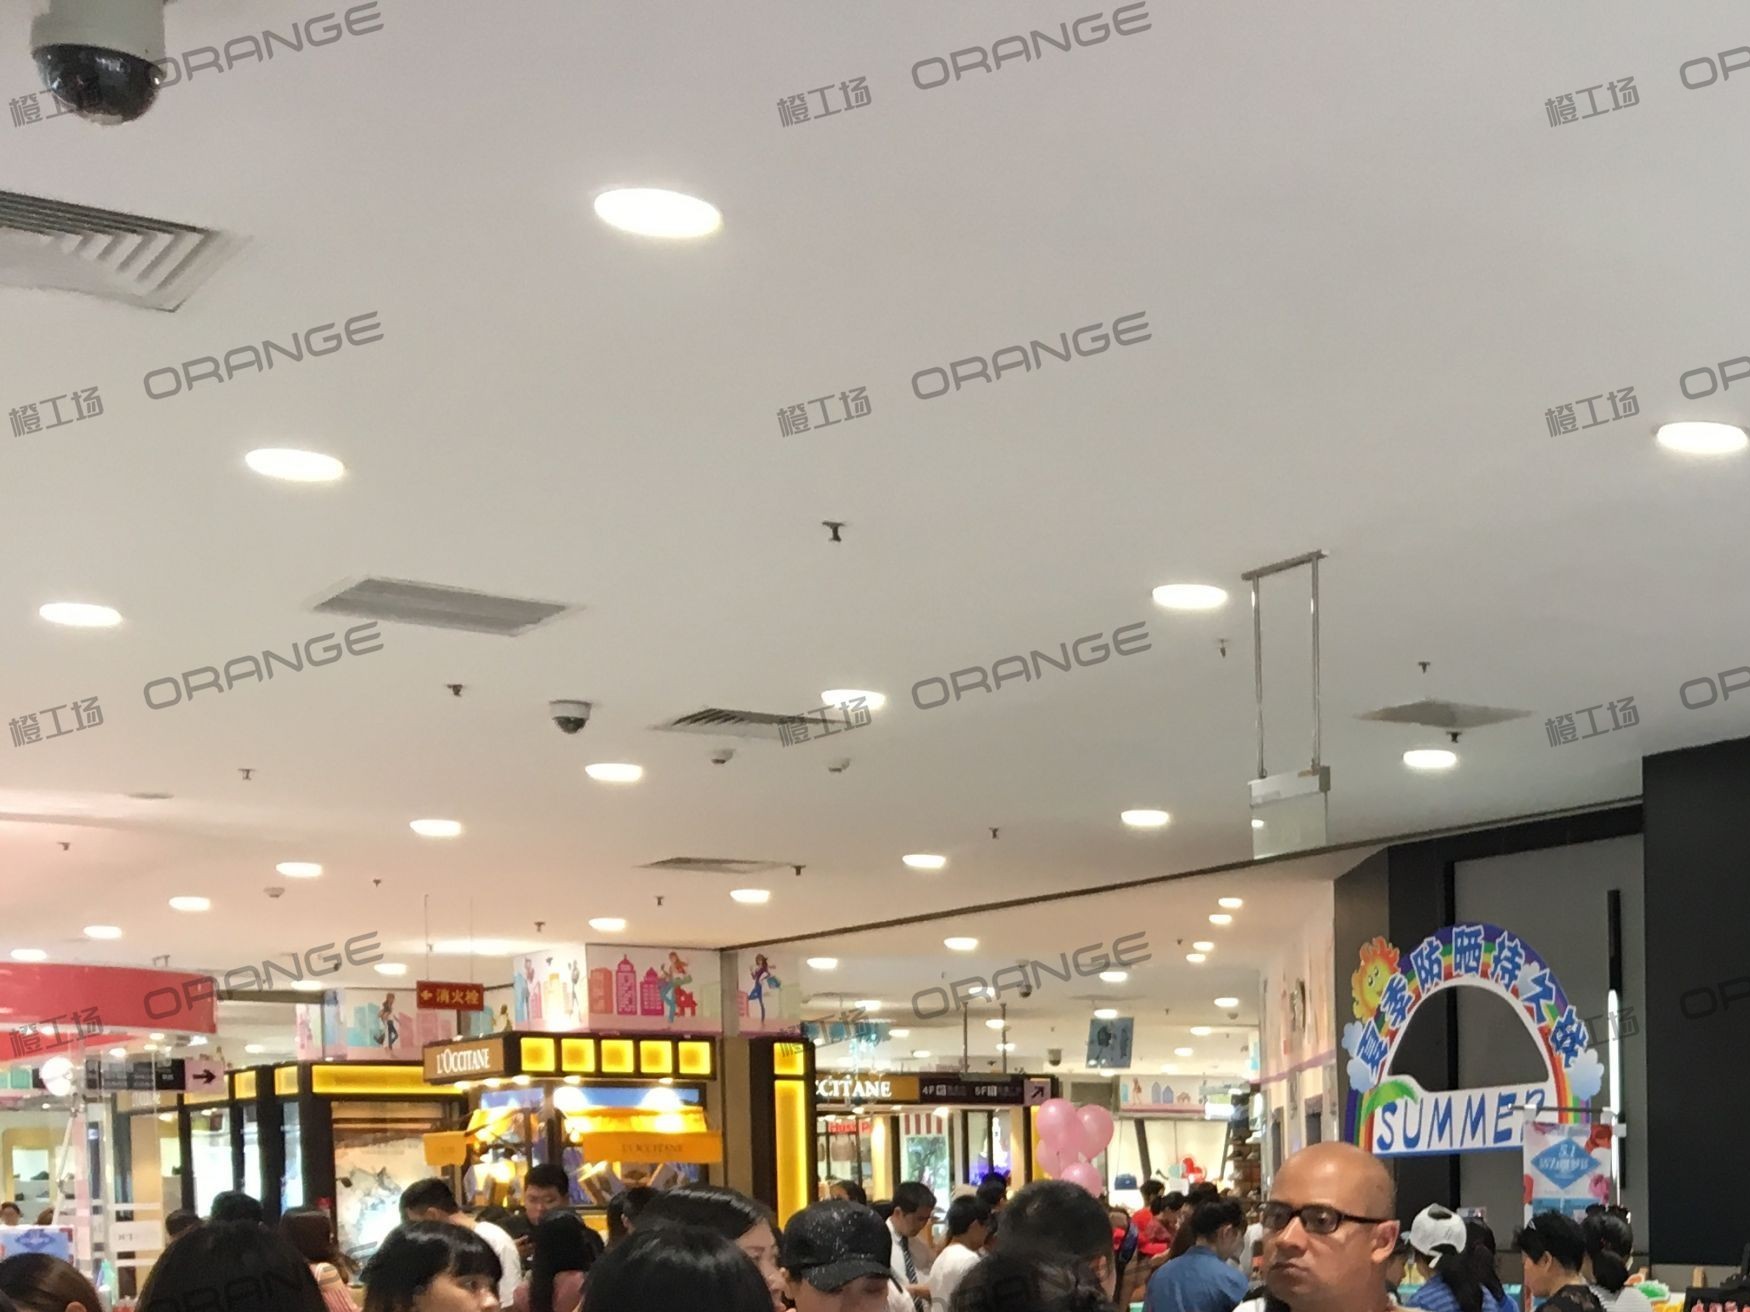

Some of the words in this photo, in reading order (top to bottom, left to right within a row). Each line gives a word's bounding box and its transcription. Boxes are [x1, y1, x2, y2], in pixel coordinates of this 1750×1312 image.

[436, 988, 479, 1005] 消火栓
[1357, 924, 1588, 1081] 夏季防晒持久战
